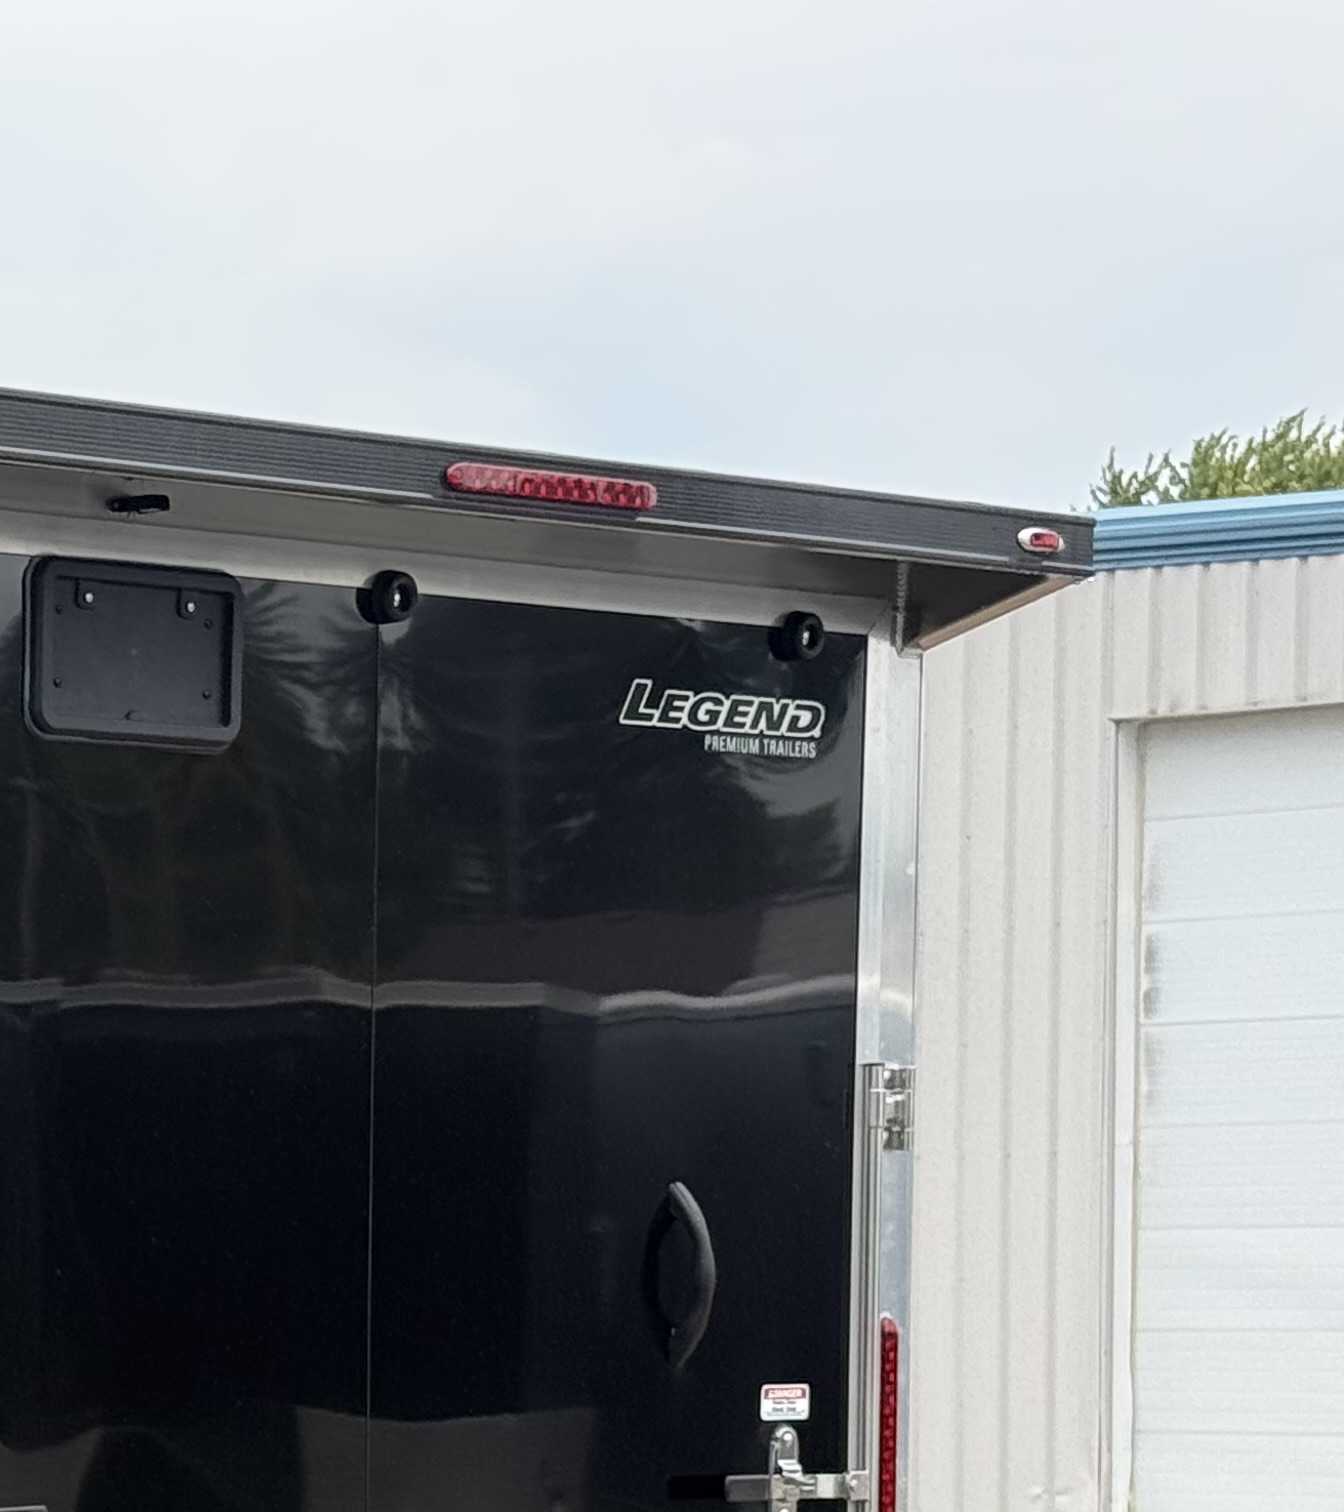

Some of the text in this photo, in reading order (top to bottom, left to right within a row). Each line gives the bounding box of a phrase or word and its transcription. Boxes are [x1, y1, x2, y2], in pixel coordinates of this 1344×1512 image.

[619, 678, 826, 738] LEGEND
[704, 734, 817, 758] PREMIUM TRAILERS
